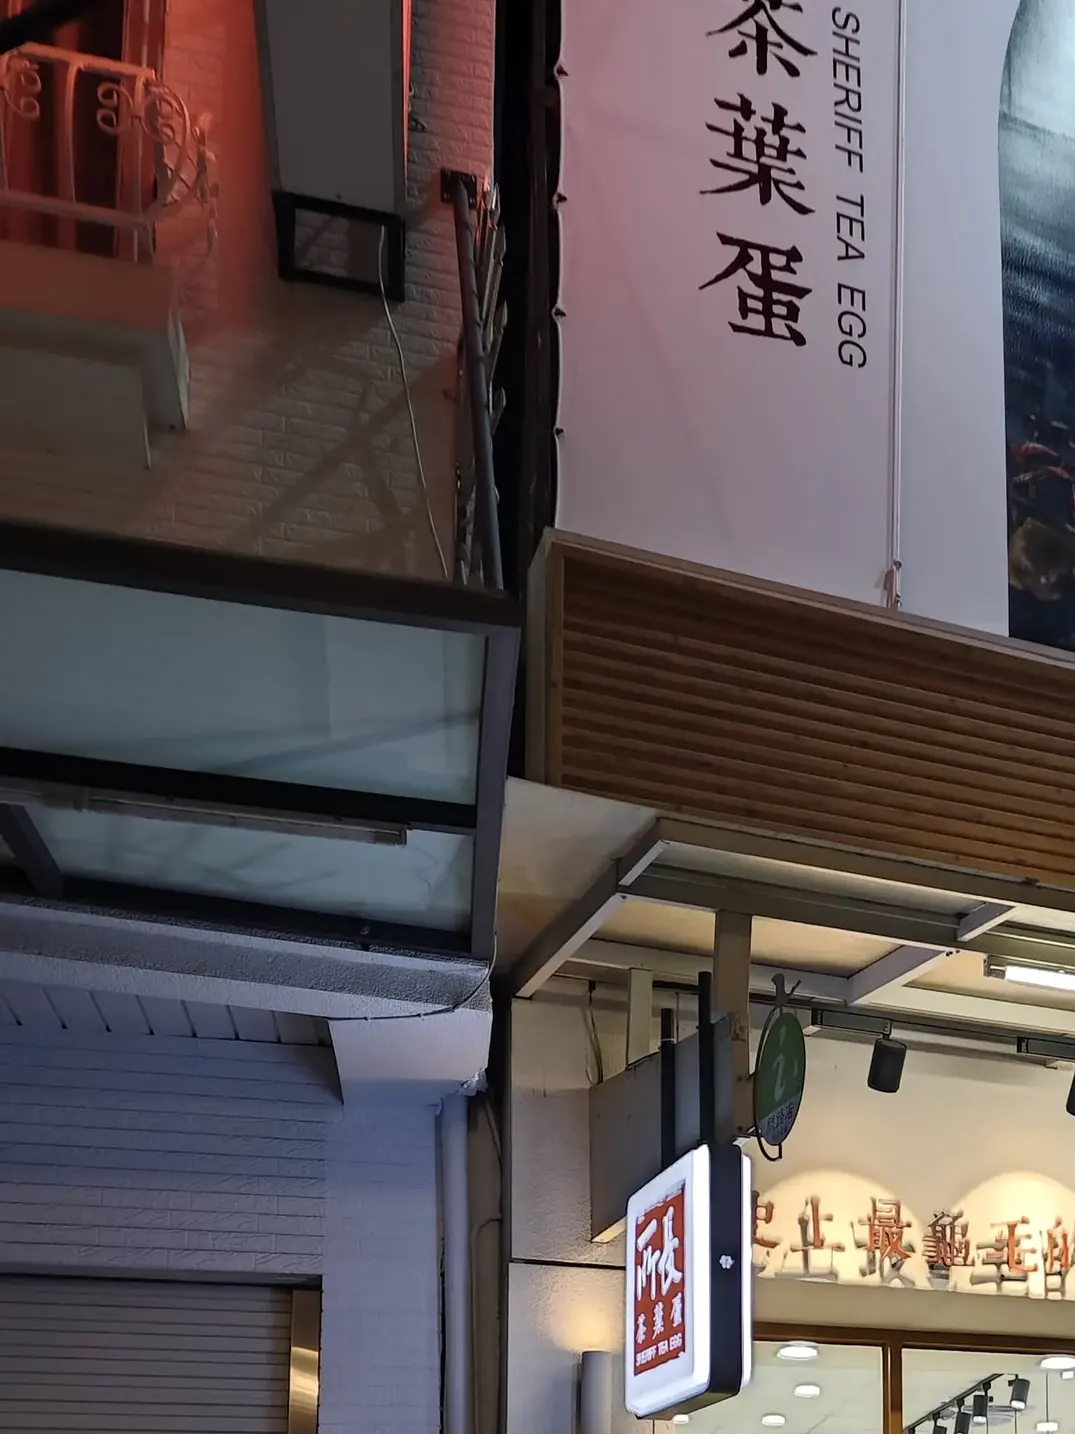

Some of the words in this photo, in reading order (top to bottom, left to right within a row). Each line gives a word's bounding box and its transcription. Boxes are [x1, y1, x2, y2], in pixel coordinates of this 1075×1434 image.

[831, 7, 864, 173] SHERIFF
[699, 0, 818, 347] 茶葉蛋
[836, 195, 866, 262] TEA
[837, 283, 868, 369] EGG
